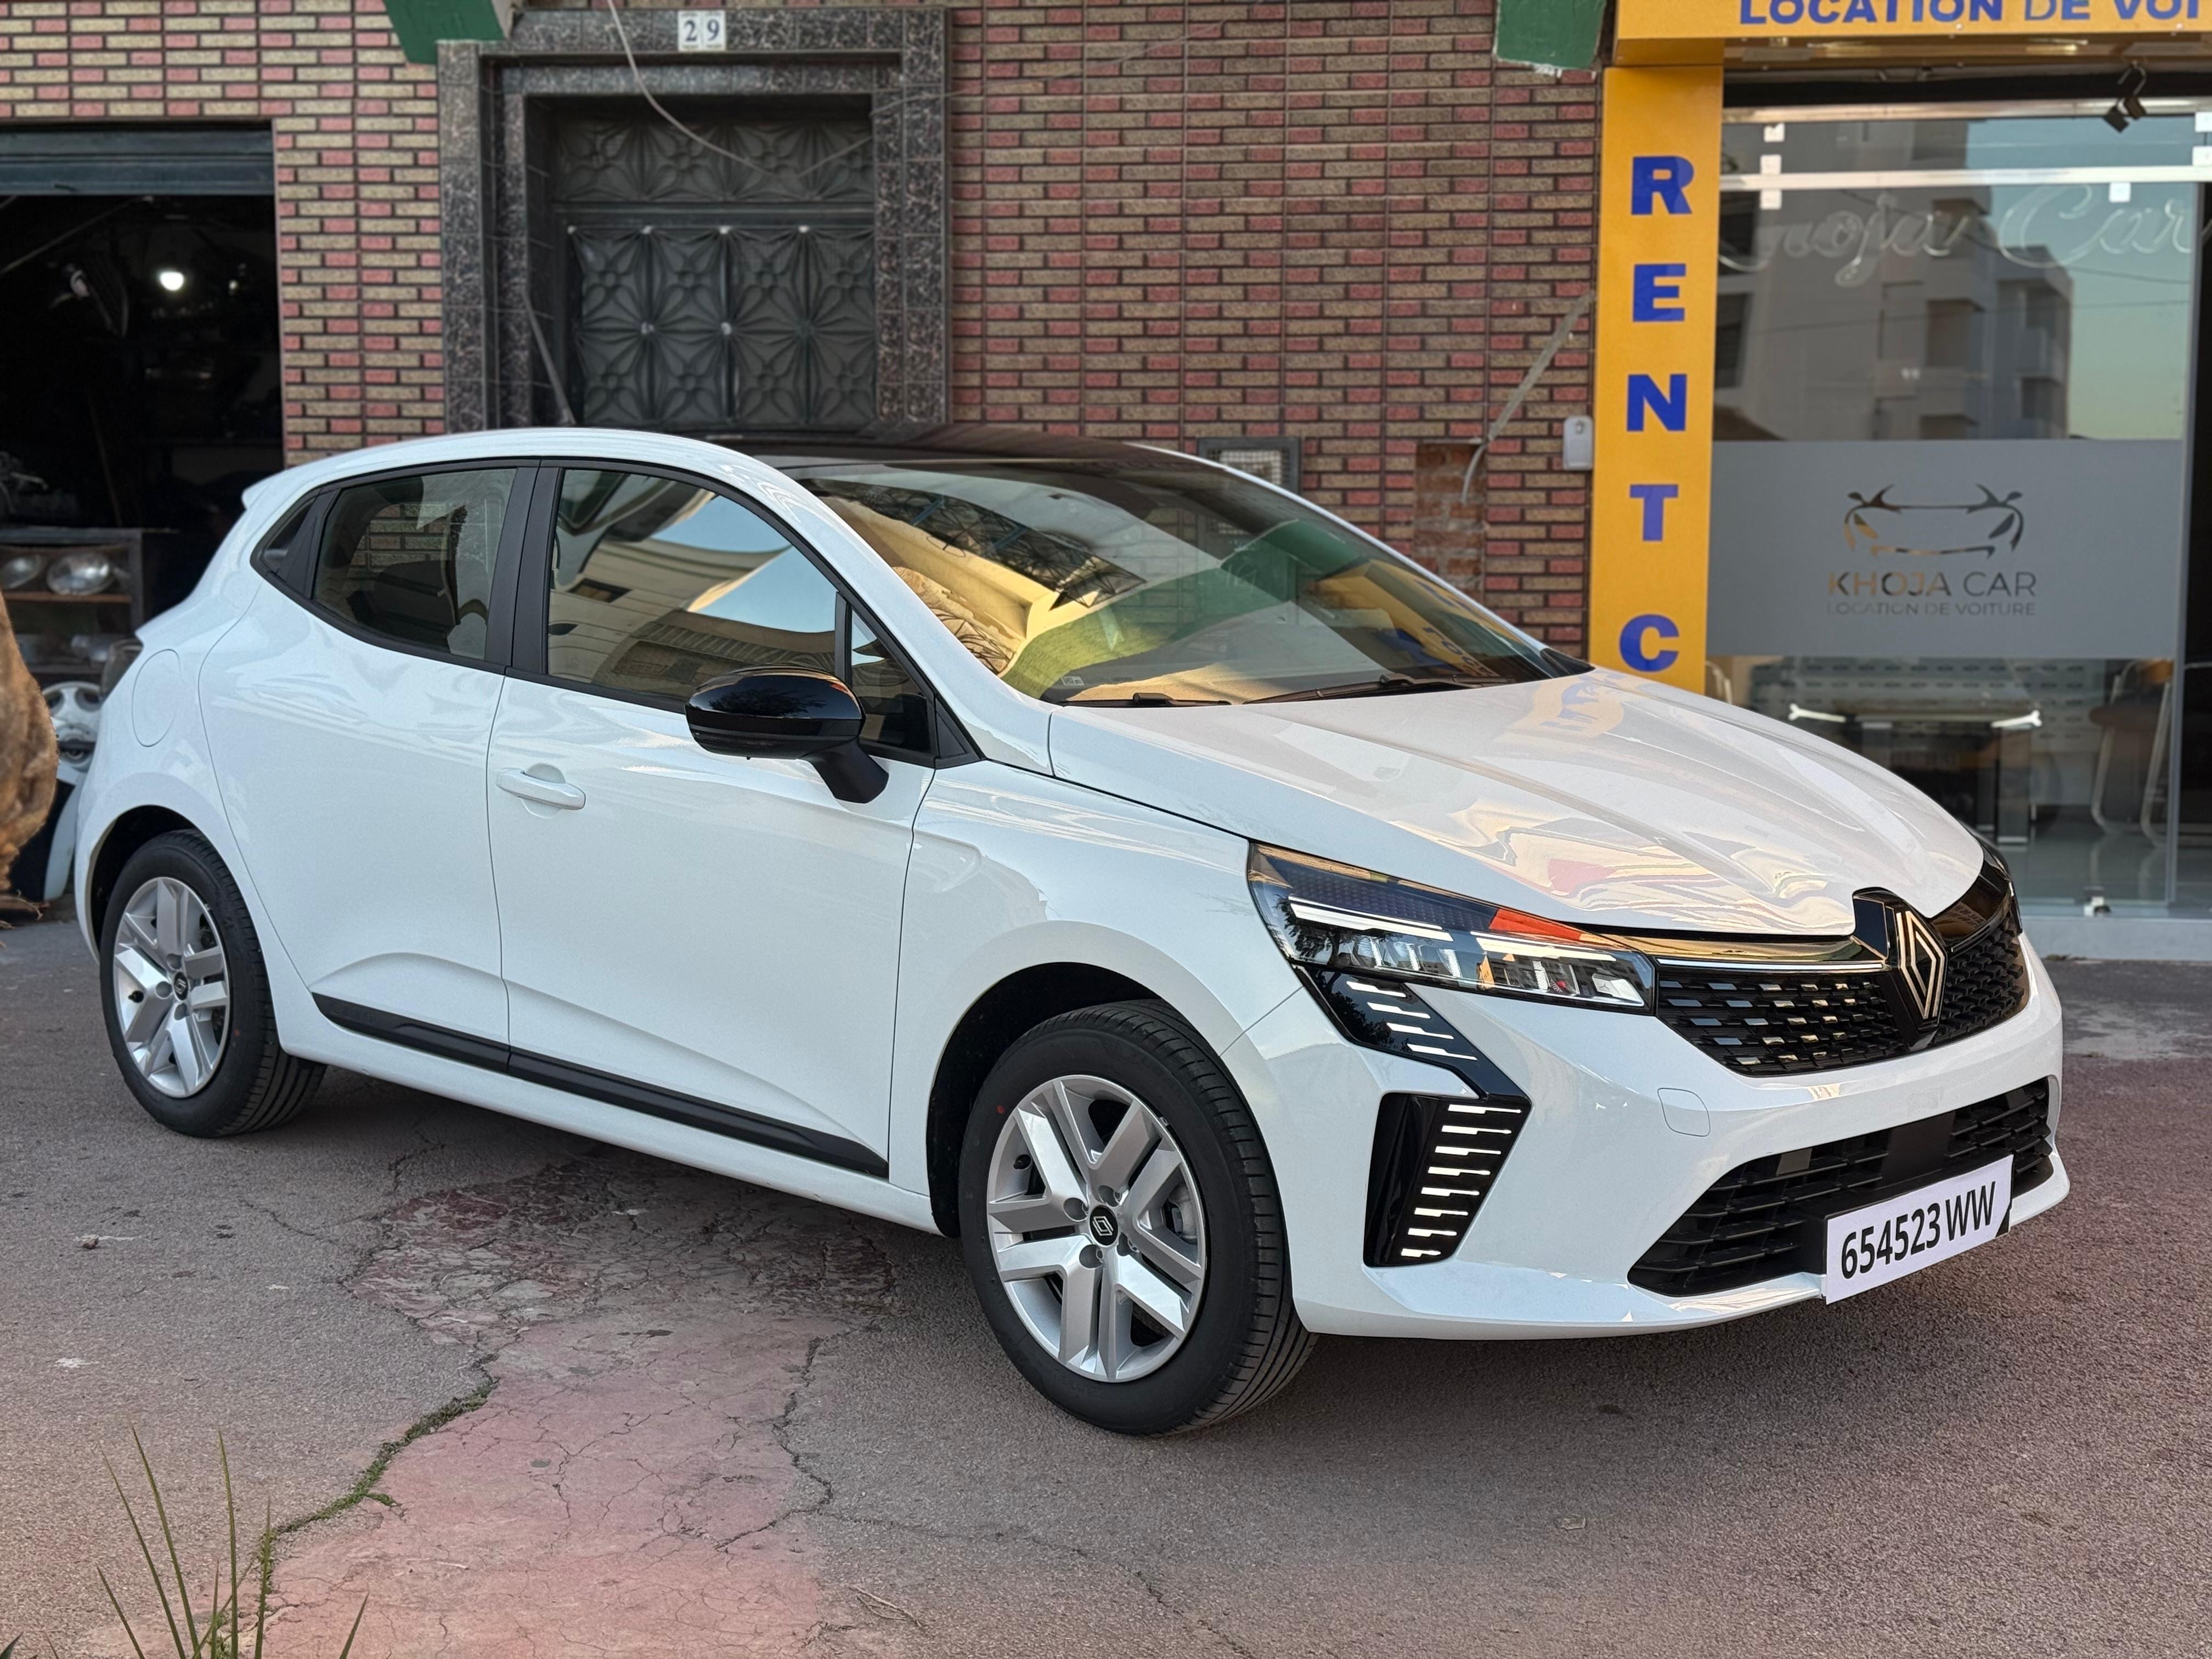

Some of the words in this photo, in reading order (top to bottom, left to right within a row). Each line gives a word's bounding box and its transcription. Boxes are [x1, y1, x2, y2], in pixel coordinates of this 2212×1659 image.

[1740, 0, 2002, 24] LOCATION
[2024, 0, 2090, 20] DE
[685, 19, 720, 42] 29
[1626, 155, 1695, 541] RENT
[1827, 572, 1952, 597] KHOJA
[1963, 571, 2037, 597] CAR
[1826, 602, 1918, 615] LOCATION
[1924, 602, 1950, 616] DE
[1954, 602, 2036, 616] VOITURE
[1841, 1203, 1941, 1279] 654523
[1945, 1181, 1996, 1242] WW
